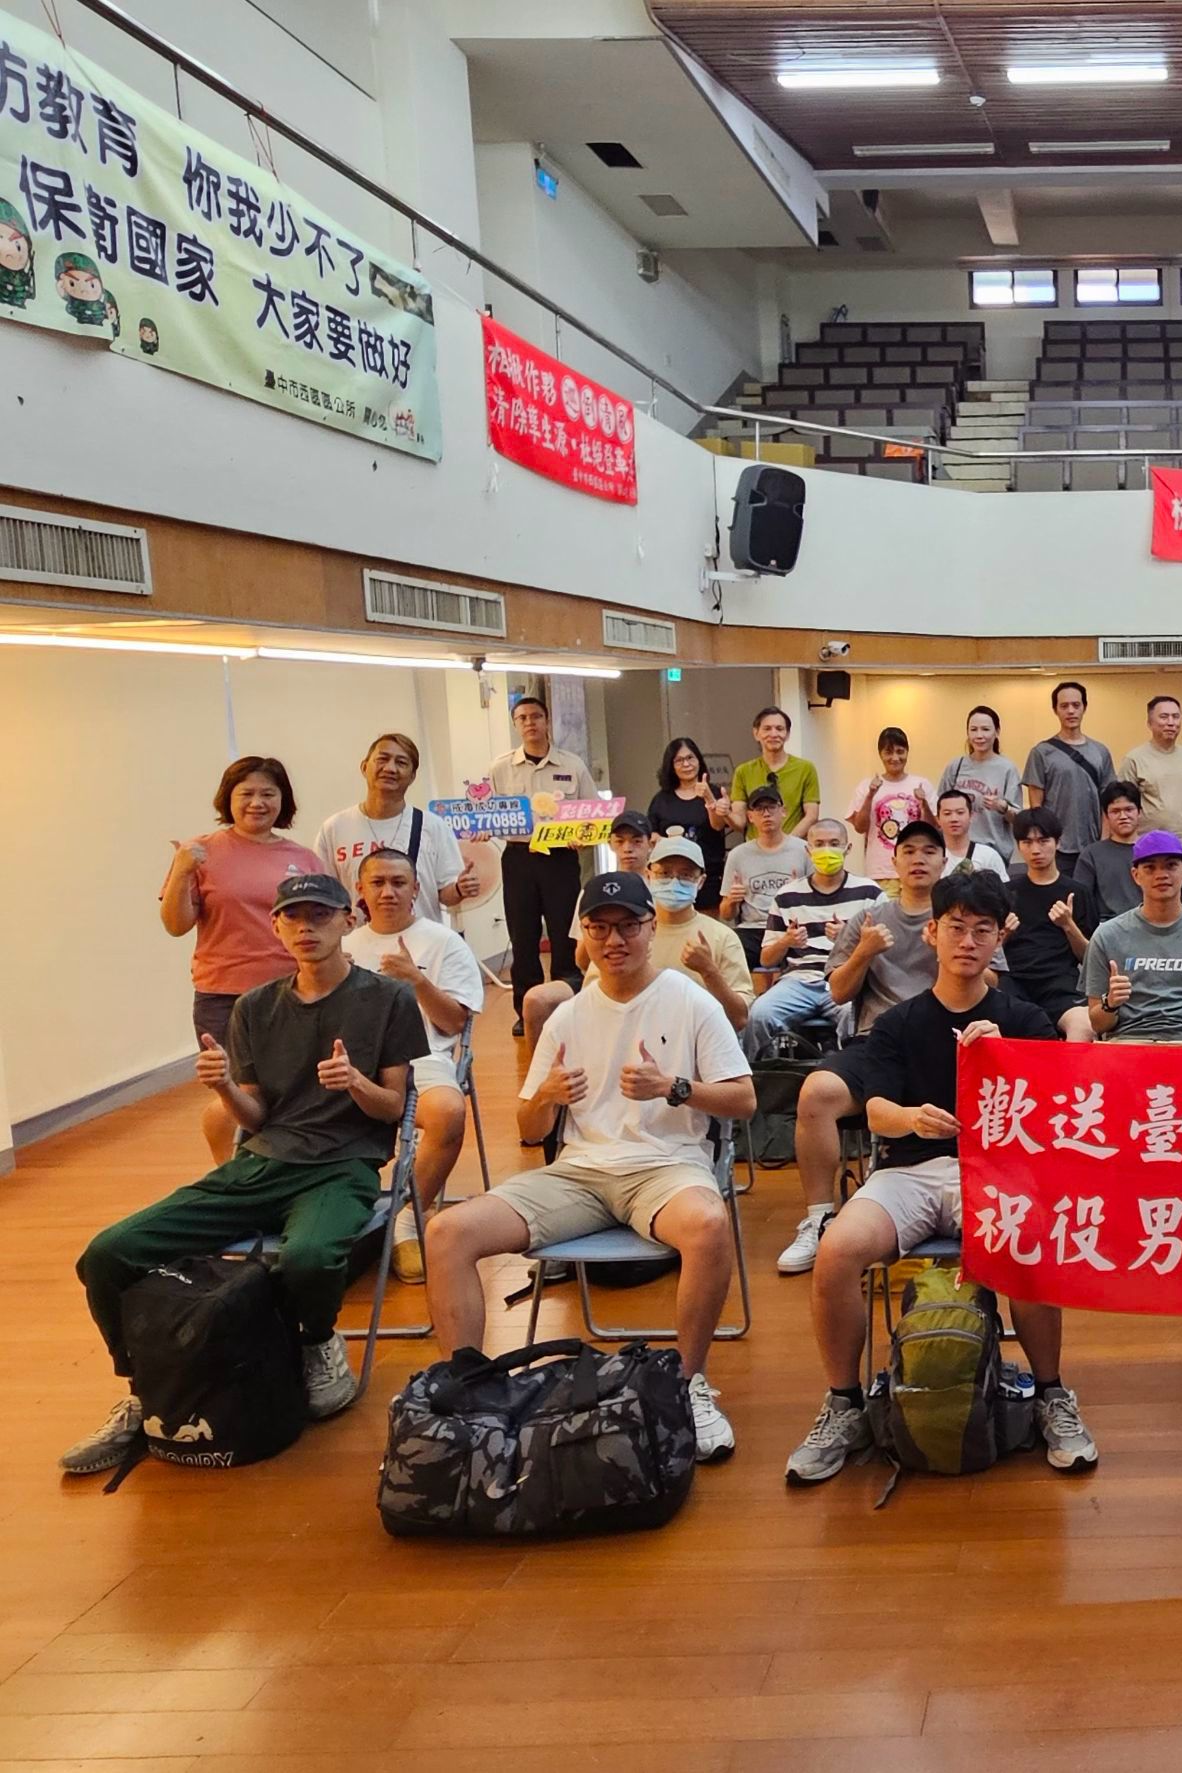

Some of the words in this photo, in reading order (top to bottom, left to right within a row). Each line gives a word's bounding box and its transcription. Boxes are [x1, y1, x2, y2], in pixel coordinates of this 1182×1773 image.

[182, 146, 366, 297] 你我少不了
[19, 155, 219, 307] 保衛國家
[252, 272, 413, 389] 大家要做好
[442, 811, 527, 832] 800-770885
[560, 801, 621, 820] 彩色人生
